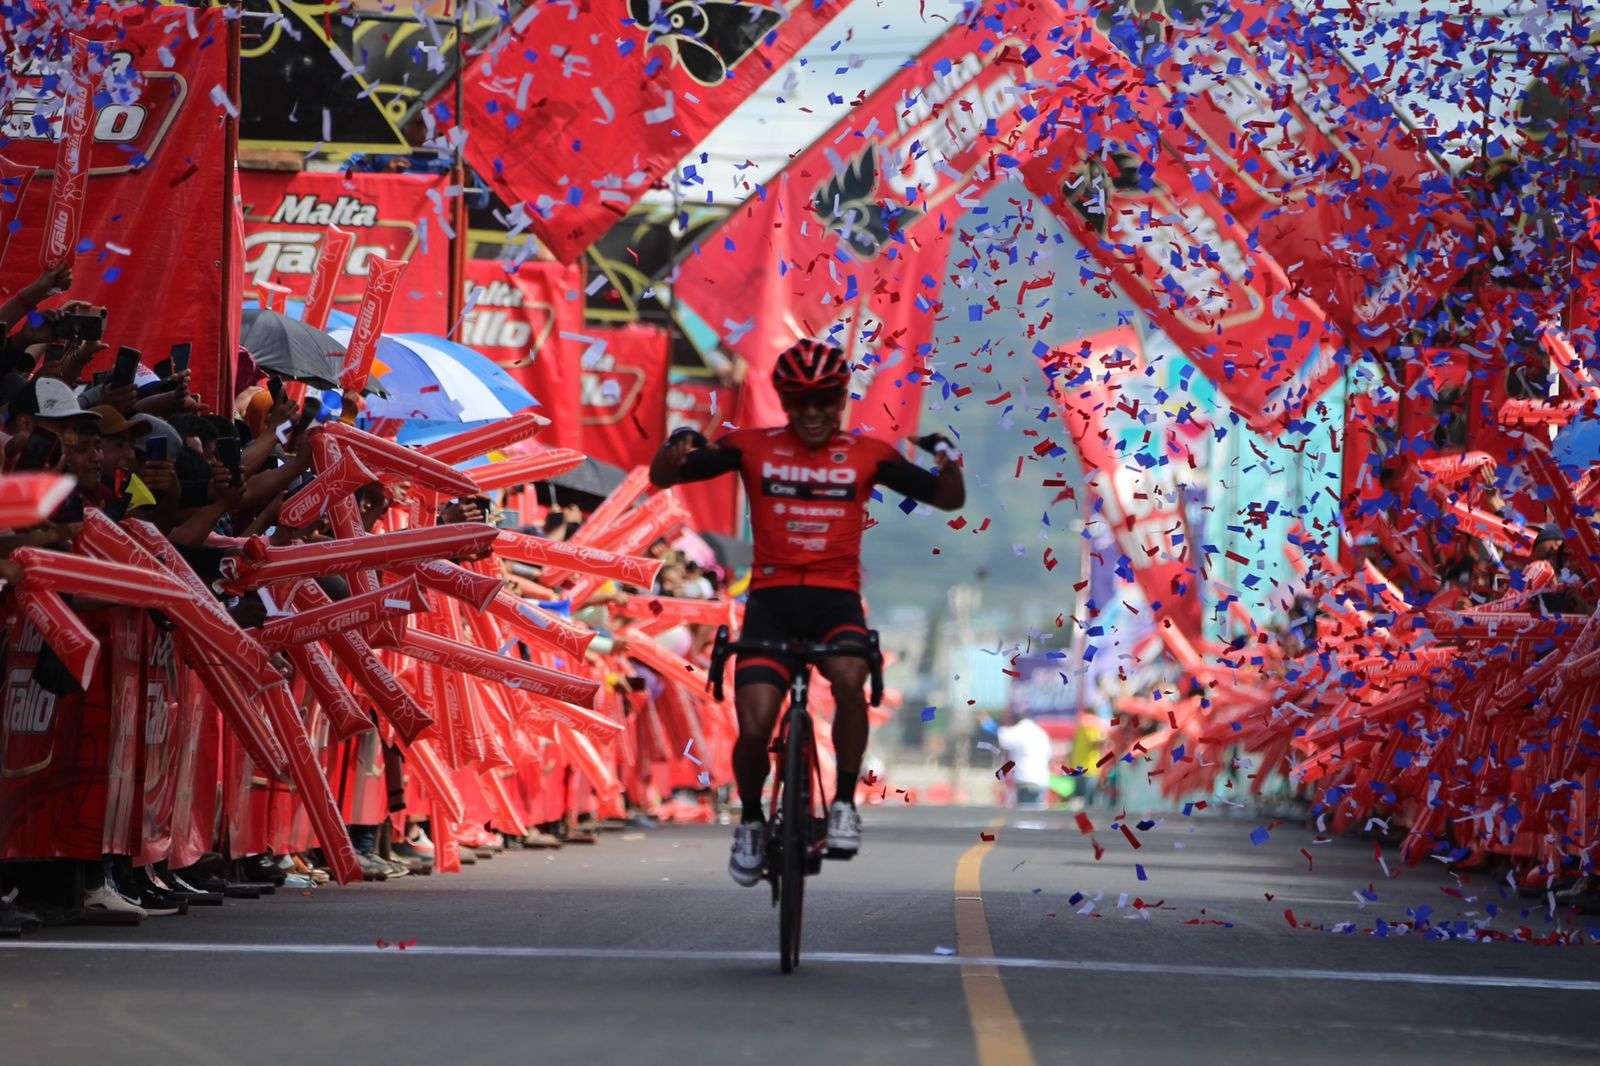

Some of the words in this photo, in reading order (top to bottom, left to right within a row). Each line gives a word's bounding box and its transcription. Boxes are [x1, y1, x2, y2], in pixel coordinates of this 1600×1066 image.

[272, 194, 378, 227] Malta
[51, 209, 70, 256] Gallo
[245, 230, 388, 287] Gao
[358, 300, 377, 340] Gallo
[762, 462, 857, 484] HINO
[288, 493, 322, 521] Gallo
[327, 609, 371, 633] Gallo
[364, 655, 398, 693] Gallo
